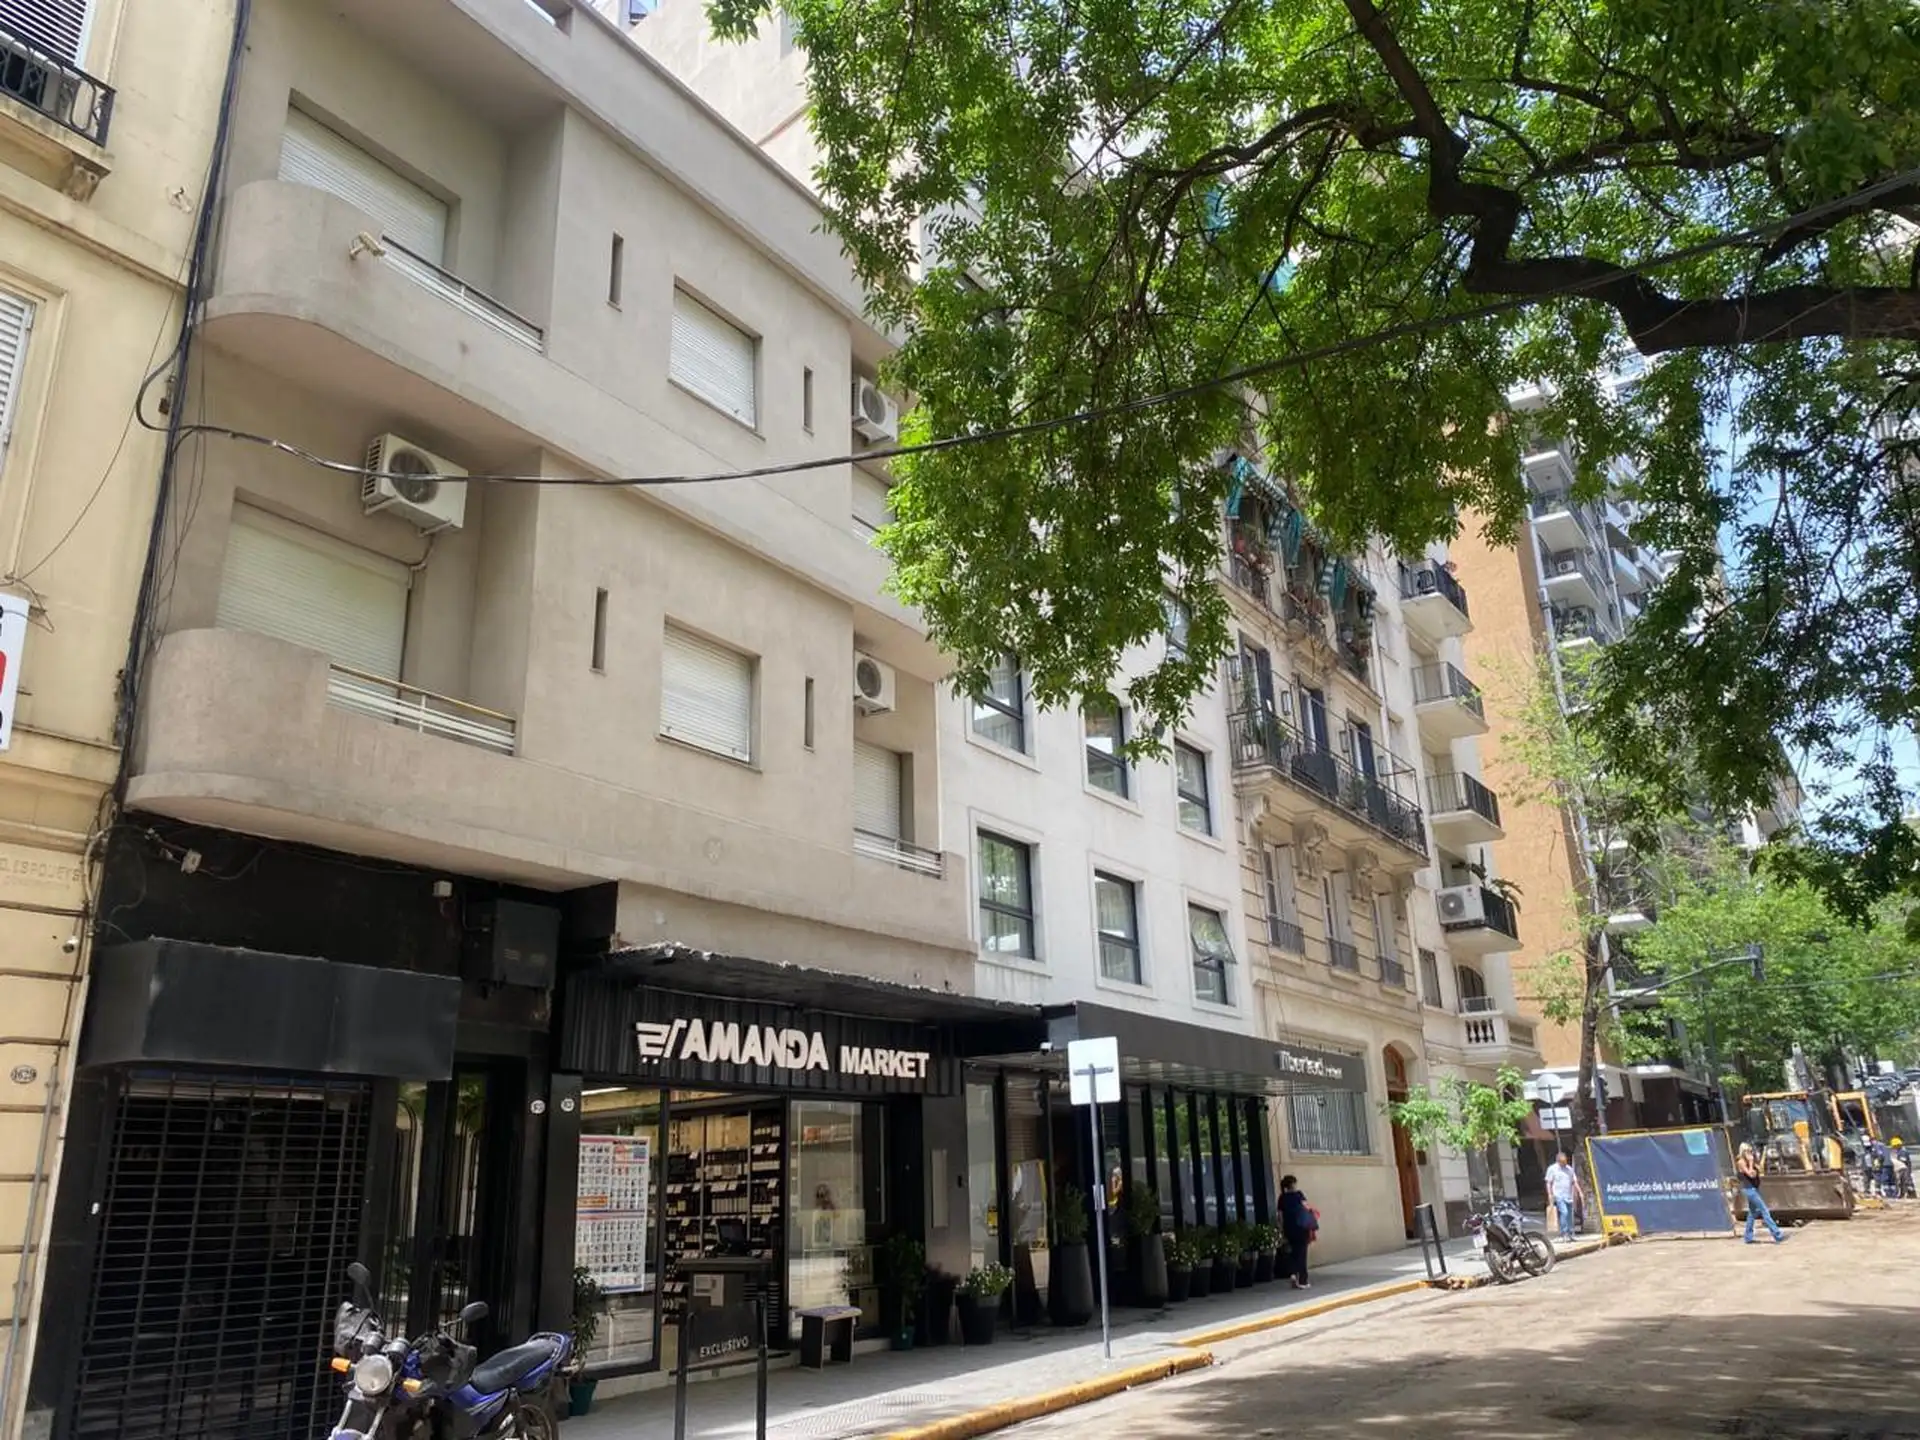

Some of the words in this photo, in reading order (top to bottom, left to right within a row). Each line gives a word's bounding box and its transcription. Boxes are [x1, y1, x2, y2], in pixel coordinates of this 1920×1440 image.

[680, 1018, 829, 1071] AMANDA
[840, 1045, 930, 1078] MARKET
[1652, 1180, 1663, 1191] de
[1664, 1180, 1672, 1191] la
[1673, 1179, 1686, 1190] red
[1687, 1178, 1719, 1191] pluvial
[700, 1335, 749, 1358] EXCLUSIVO
